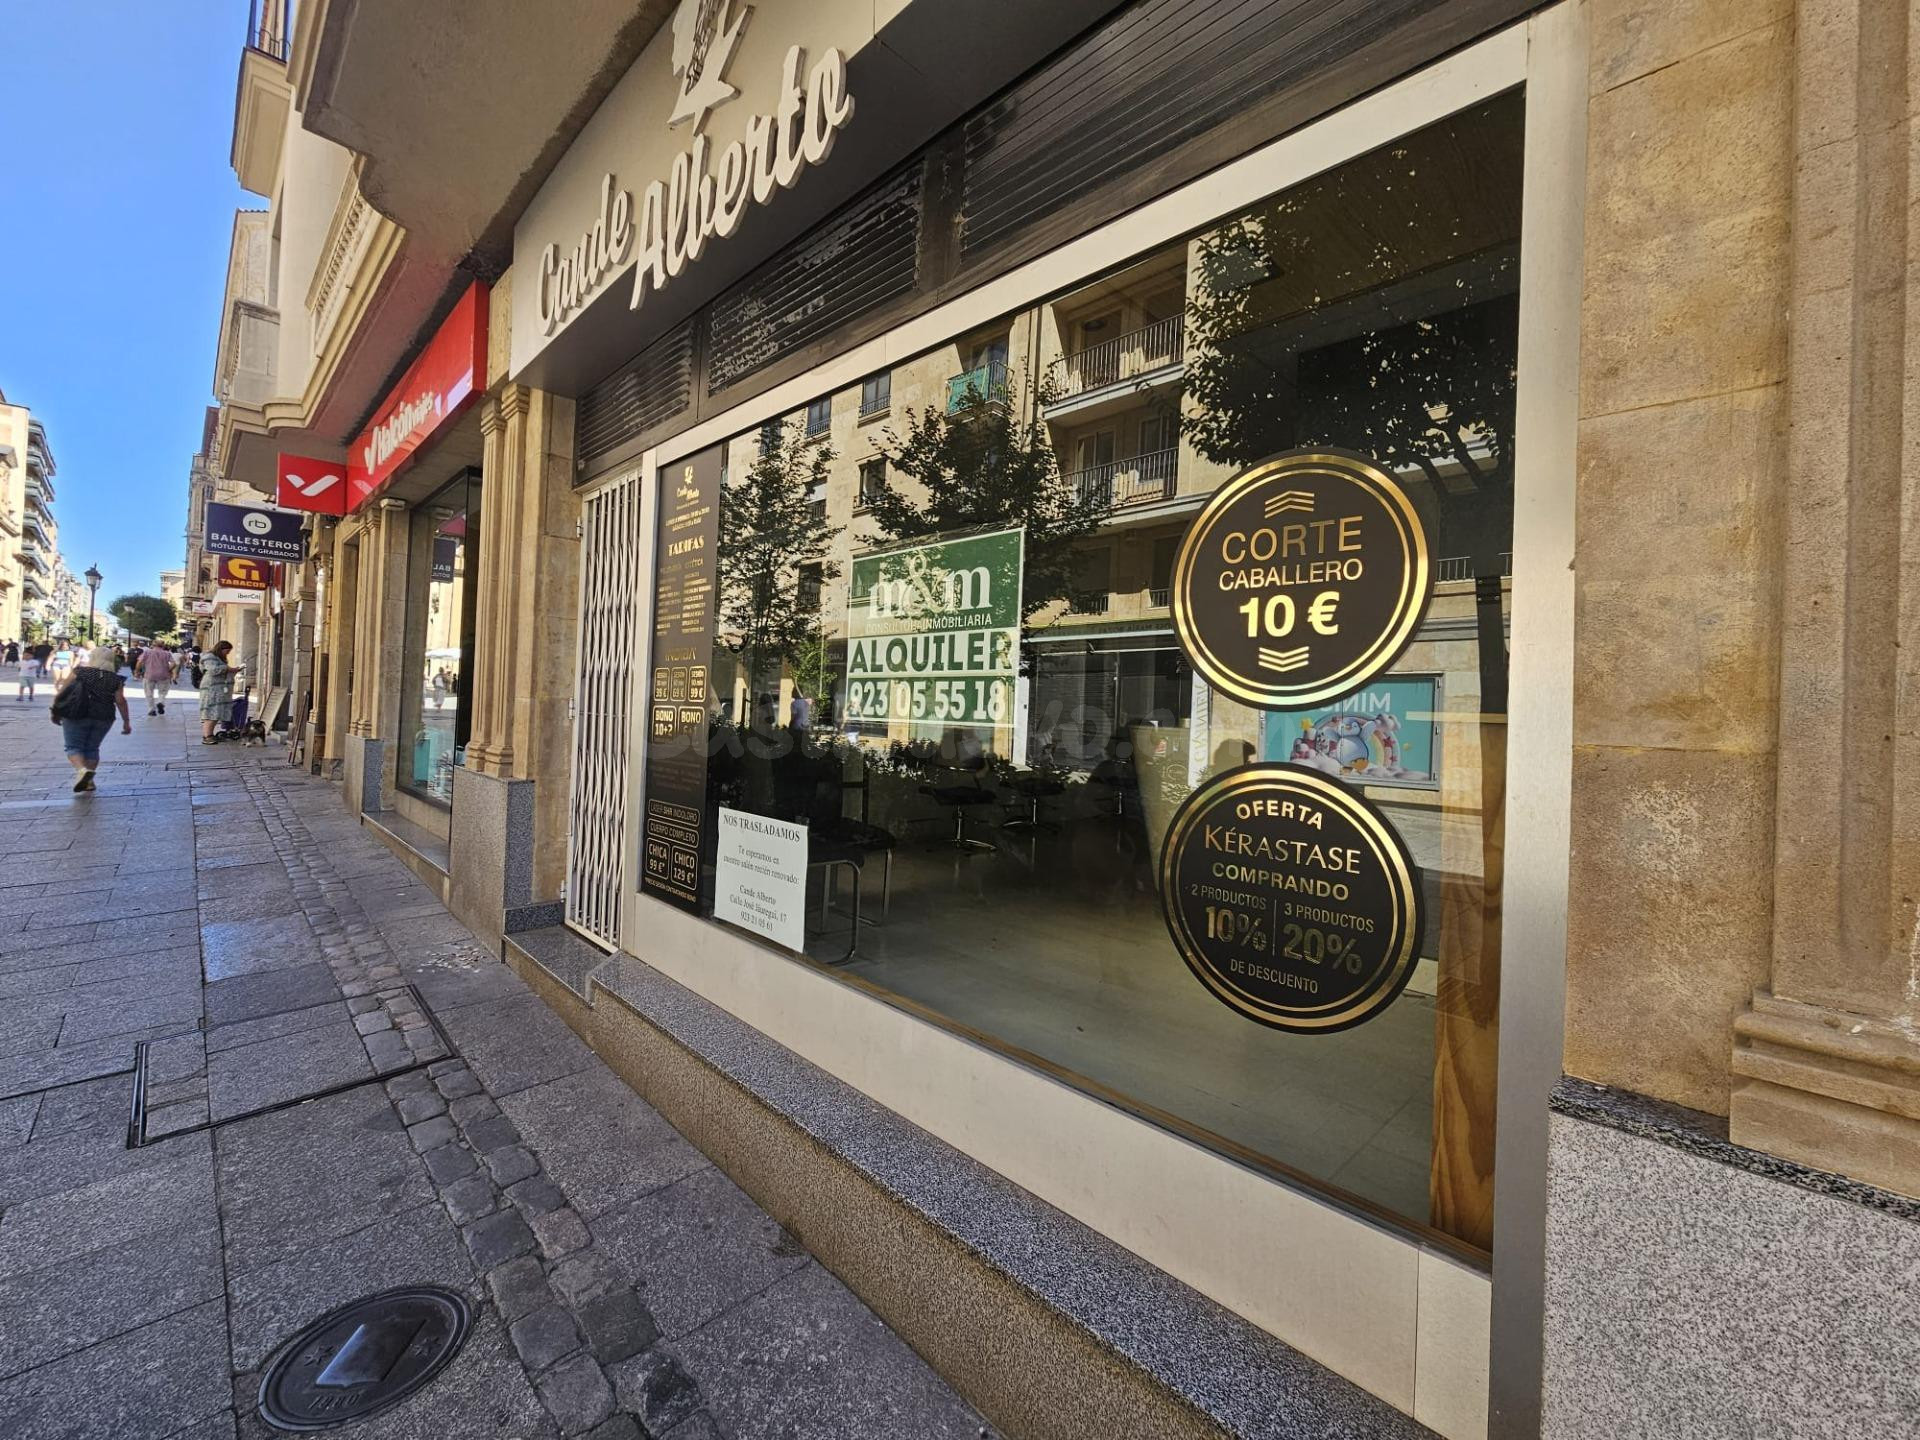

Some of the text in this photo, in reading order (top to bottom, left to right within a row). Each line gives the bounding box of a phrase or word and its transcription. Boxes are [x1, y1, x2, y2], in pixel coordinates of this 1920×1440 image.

[536, 45, 855, 336] Cande Alberto
[211, 533, 300, 551] BALLESTEROS
[211, 543, 248, 552] RÓTULOS
[258, 548, 299, 558] GRABADOS
[668, 535, 704, 556] TARIFAS
[1222, 515, 1363, 564] CORTE
[221, 579, 266, 588] TABACOS
[868, 552, 993, 620] m&m
[1219, 558, 1363, 591] CABALLERO
[924, 615, 993, 630] INMOBILIARIA
[1240, 591, 1340, 638] 10 €
[850, 631, 1013, 673] ALQUILER
[850, 680, 1006, 721] 923 05 55 18
[655, 724, 673, 736] 10+2
[656, 710, 701, 724] BONO BONO
[724, 814, 800, 842] NOS TRASLADAMOS
[1236, 800, 1324, 830] OFERTA
[650, 823, 696, 844] CUERPO COMPLETO
[648, 843, 695, 869] CHICA CHICO
[1204, 824, 1361, 875] KÉRASTASE
[650, 858, 658, 870] 99
[674, 867, 686, 882] 129
[1213, 862, 1350, 901] COMPRANDO
[740, 884, 776, 906] Cande Alberto
[1191, 884, 1374, 933] 2 PRODUCTOS 3 PRODUCTOS
[1206, 906, 1363, 975] 10% 20%
[1230, 958, 1319, 994] DE DESCUENTO
